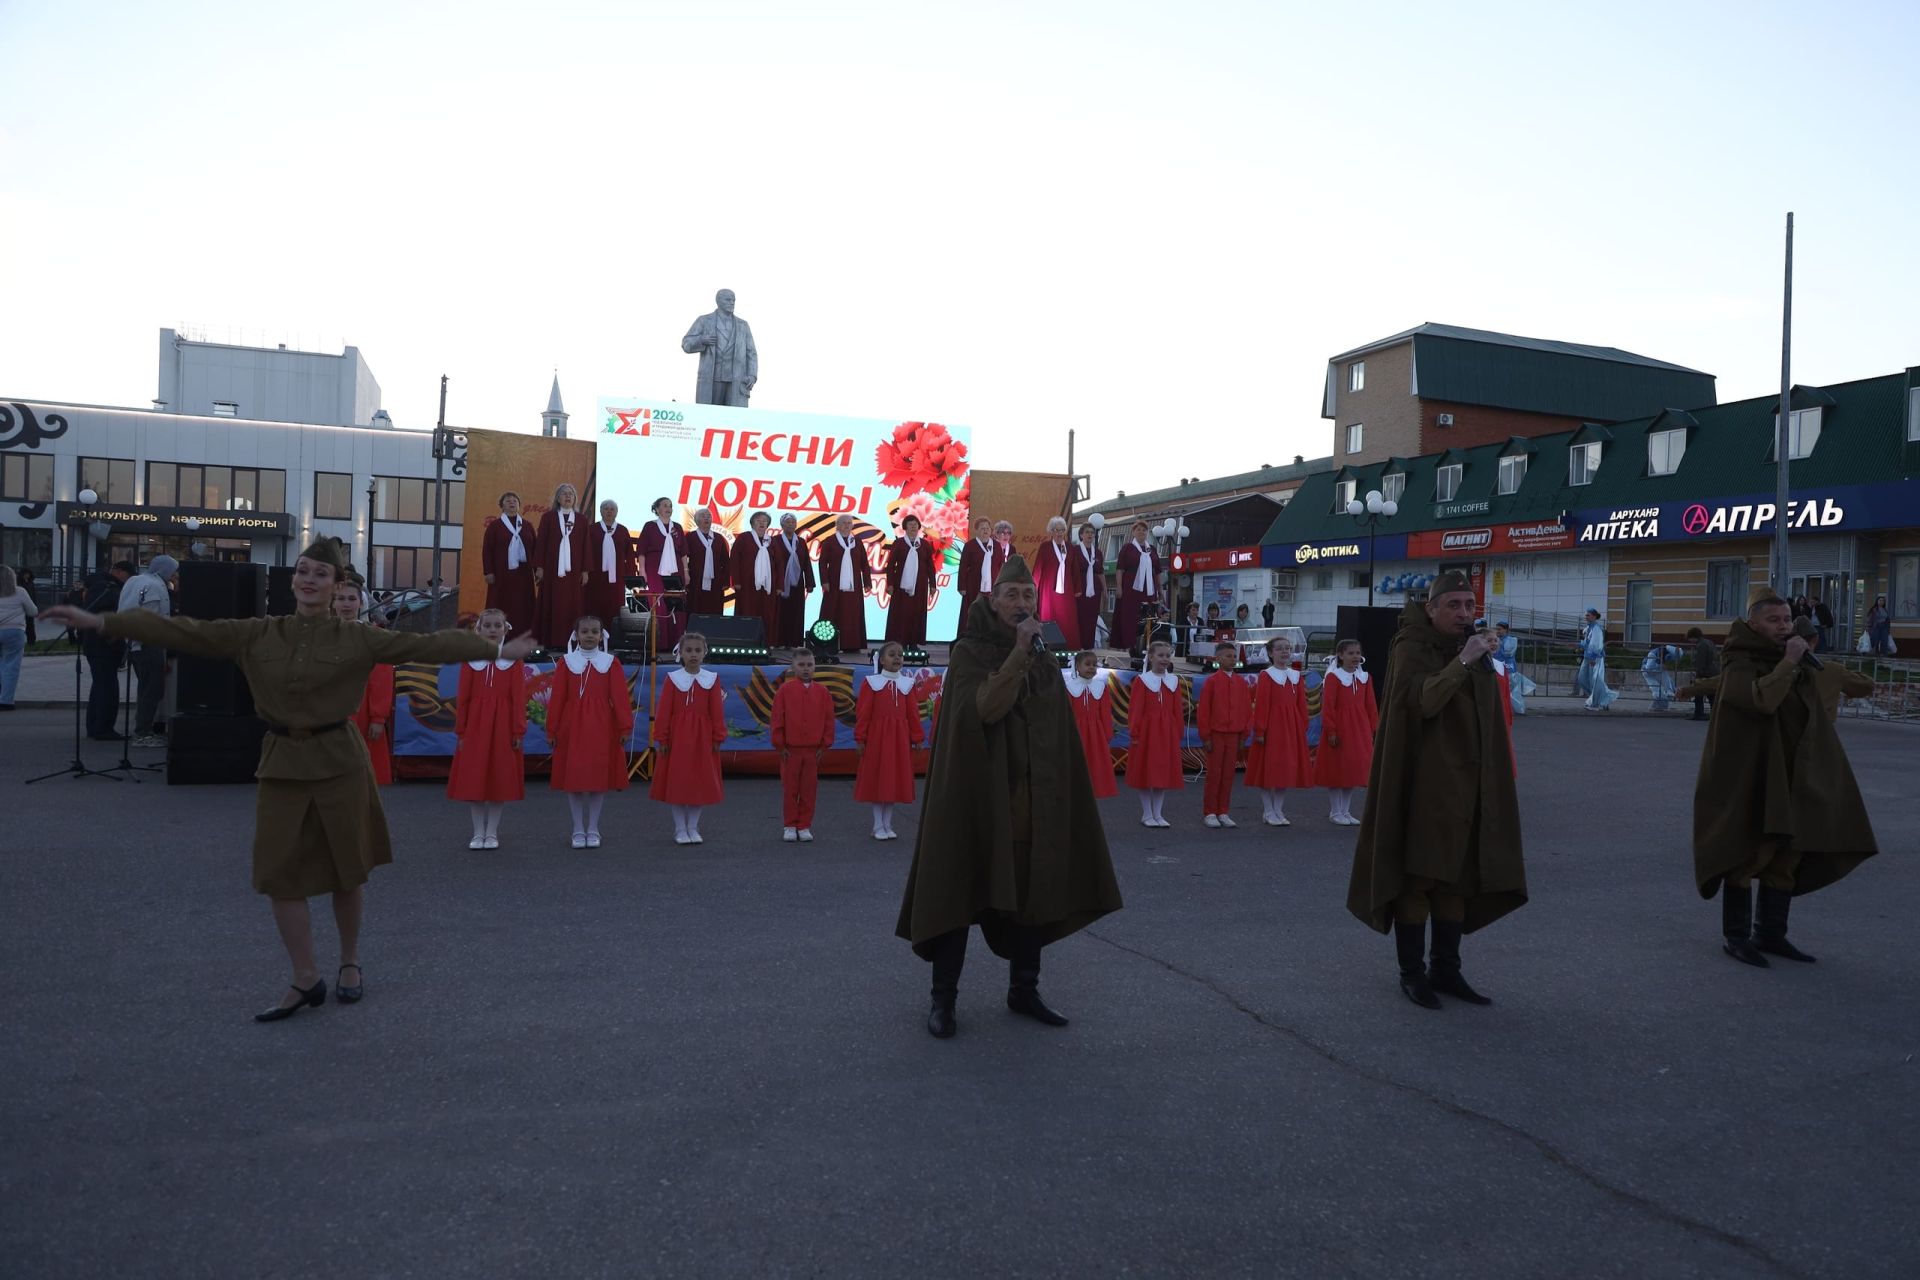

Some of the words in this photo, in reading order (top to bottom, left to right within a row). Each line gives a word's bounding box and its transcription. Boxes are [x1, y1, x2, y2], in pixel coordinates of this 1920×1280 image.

[653, 409, 684, 421] 2026
[700, 428, 854, 467] ПЕСНИ
[678, 475, 873, 514] ПОБЕДЫ
[1447, 506, 1460, 515] 1741
[1462, 502, 1489, 512] COFFEE
[1610, 507, 1660, 520] ДАРУХАНӘ
[238, 518, 277, 528] ЙОРТЫ
[1580, 519, 1658, 541] АПТЕКА
[1444, 533, 1489, 546] МАГНИТ
[1321, 545, 1359, 557] ОПТИКА
